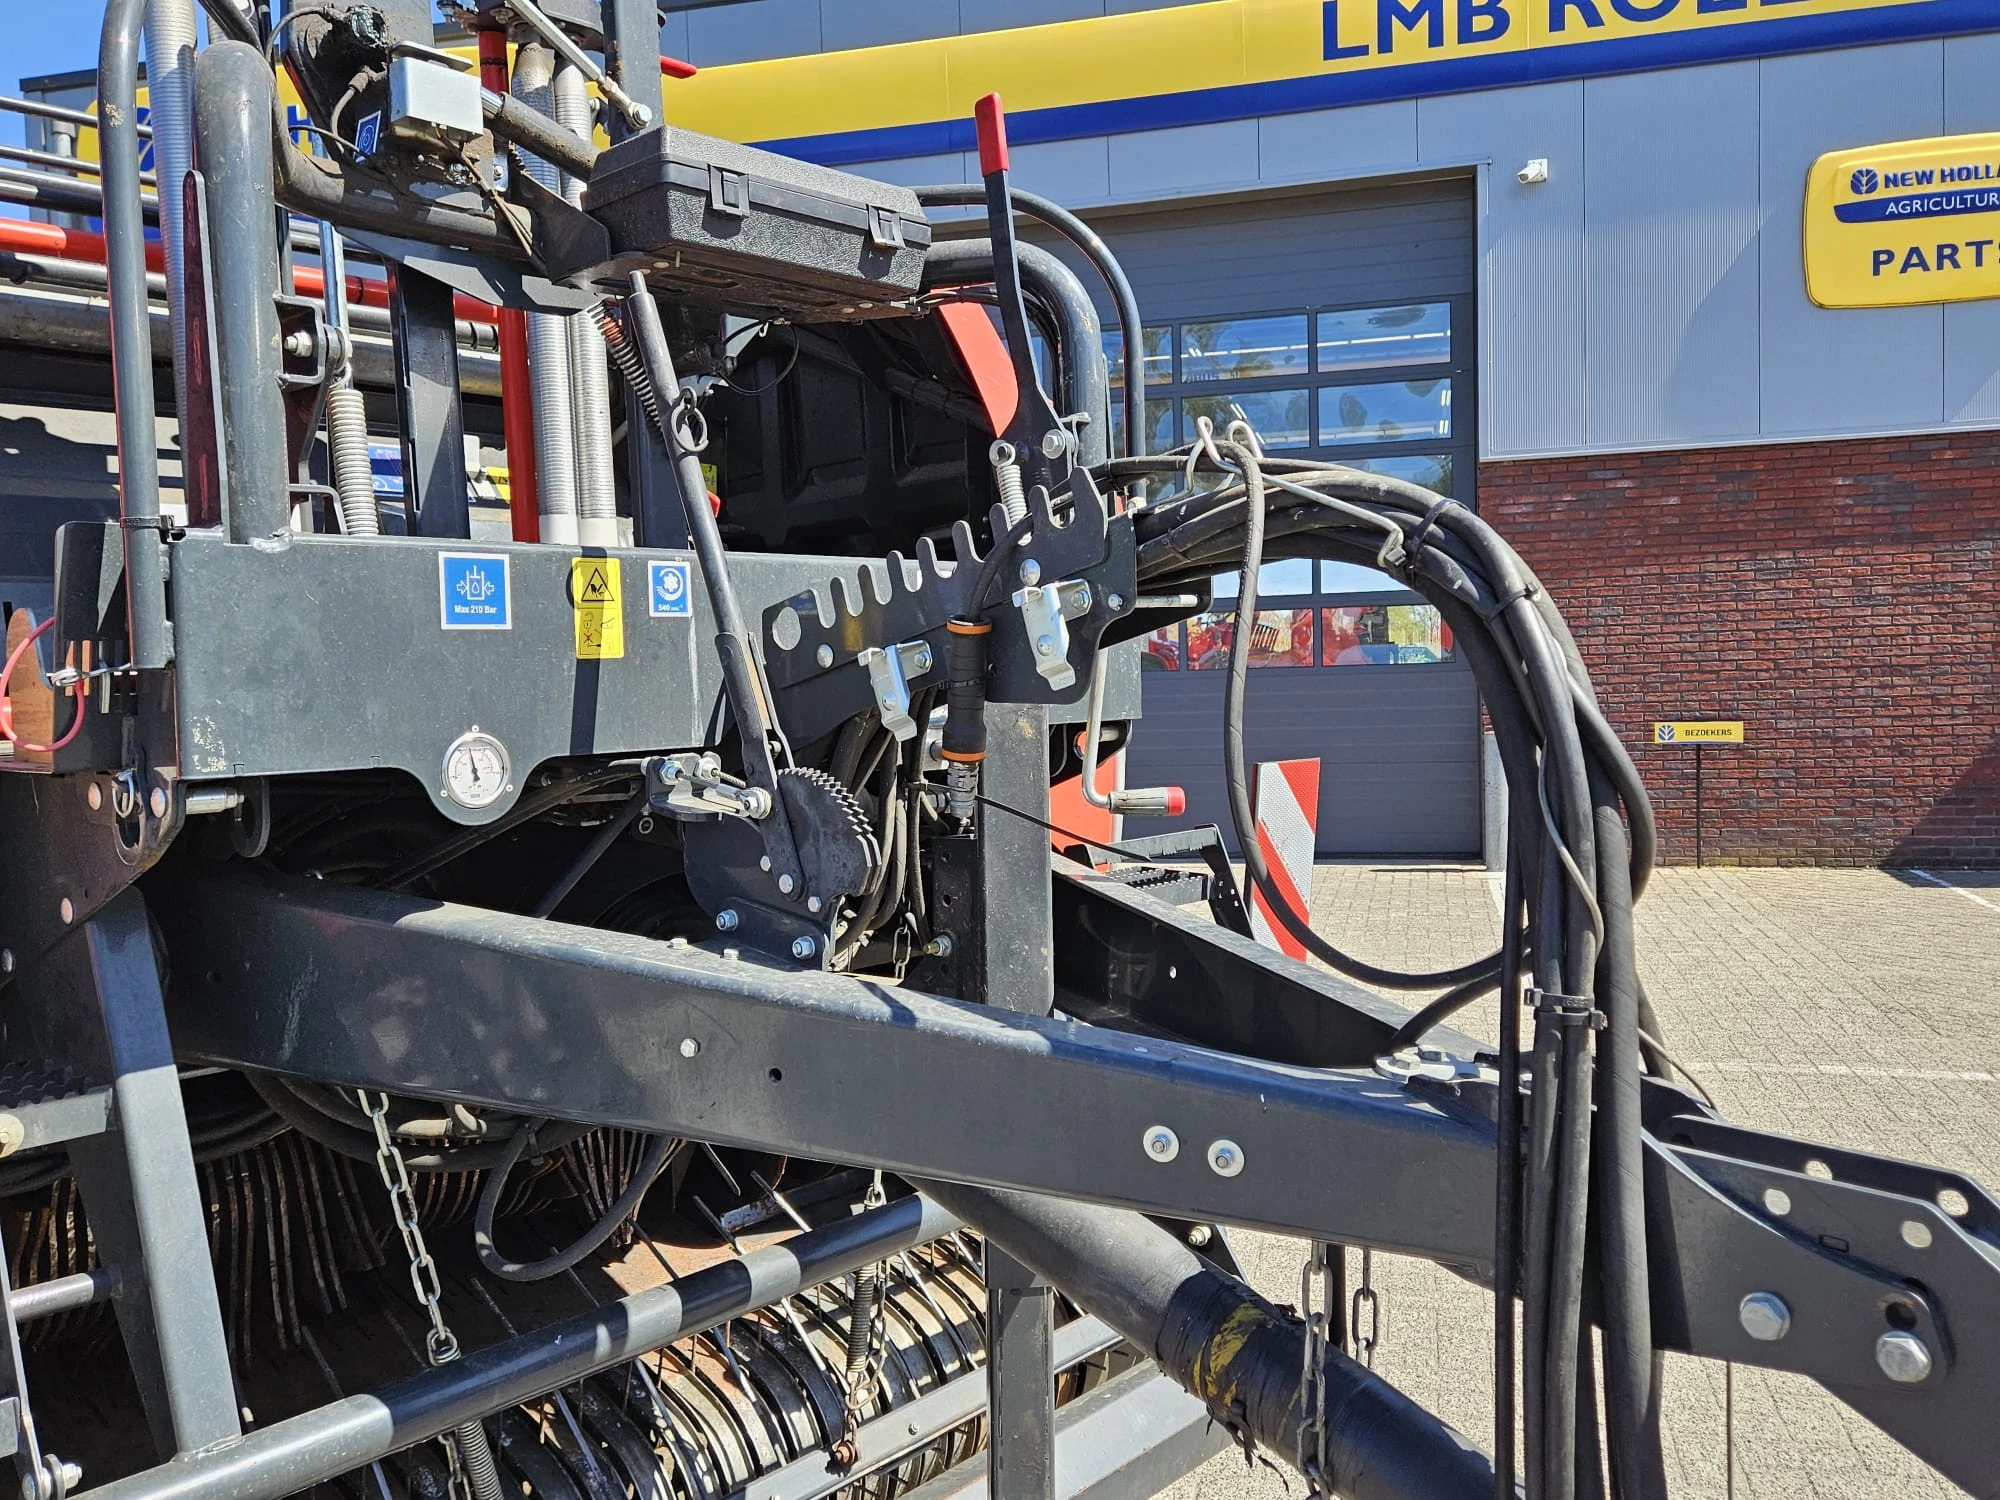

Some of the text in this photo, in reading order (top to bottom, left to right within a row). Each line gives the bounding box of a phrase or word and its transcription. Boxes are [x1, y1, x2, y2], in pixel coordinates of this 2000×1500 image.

[1323, 0, 1510, 61] LMB
[1884, 162, 2000, 189] NEW HOLL
[1872, 239, 2000, 277] PART
[454, 604, 497, 614] Max 210 Bar
[658, 604, 670, 612] 540
[1685, 728, 1732, 737] BEZOEKERS
